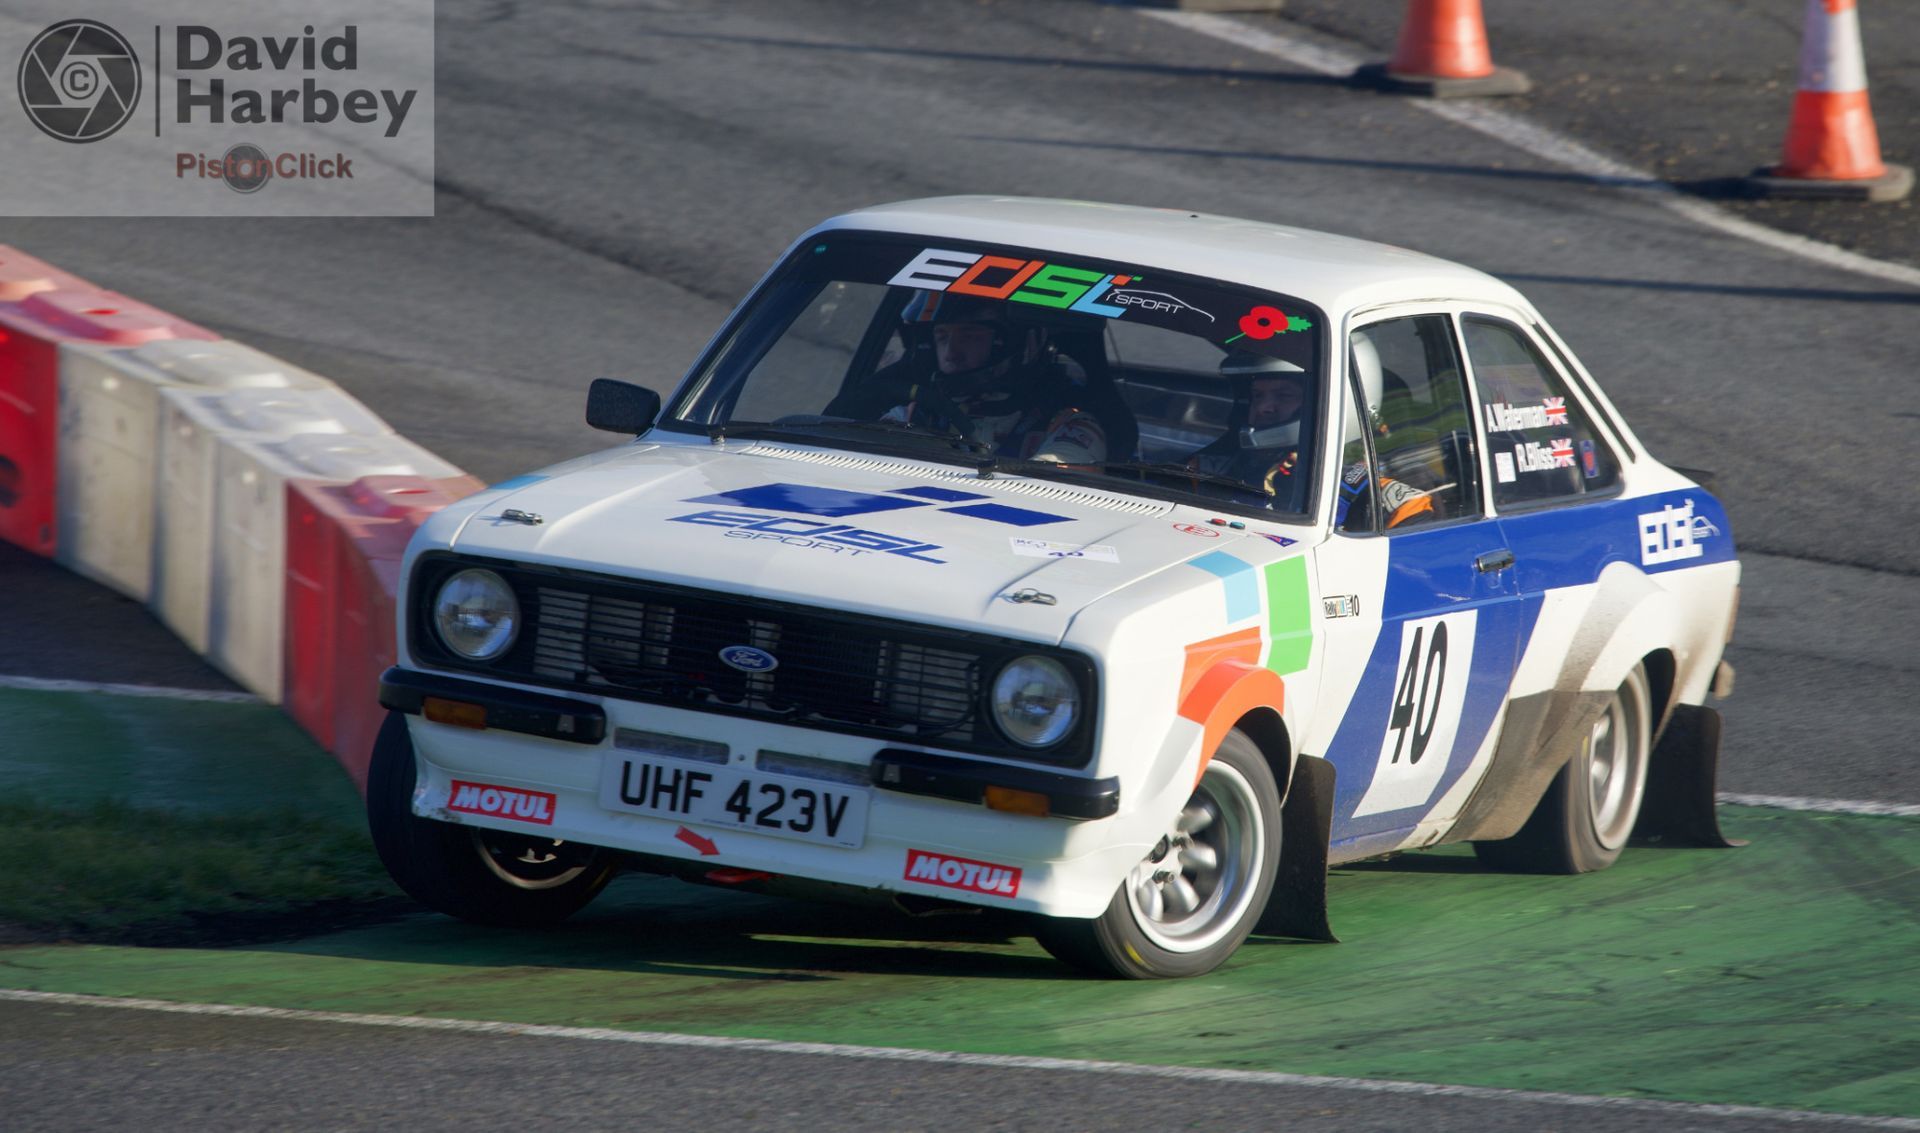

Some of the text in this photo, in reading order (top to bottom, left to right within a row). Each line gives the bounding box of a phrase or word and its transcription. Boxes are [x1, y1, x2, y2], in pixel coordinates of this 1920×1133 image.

[1115, 294, 1184, 314] SPORT
[723, 529, 872, 556] SPORT
[731, 649, 764, 668] Ford
[1390, 620, 1449, 766] 40
[451, 784, 551, 821] MOTUL
[620, 760, 850, 838] UHF 423V
[908, 854, 1016, 894] MOTUL
